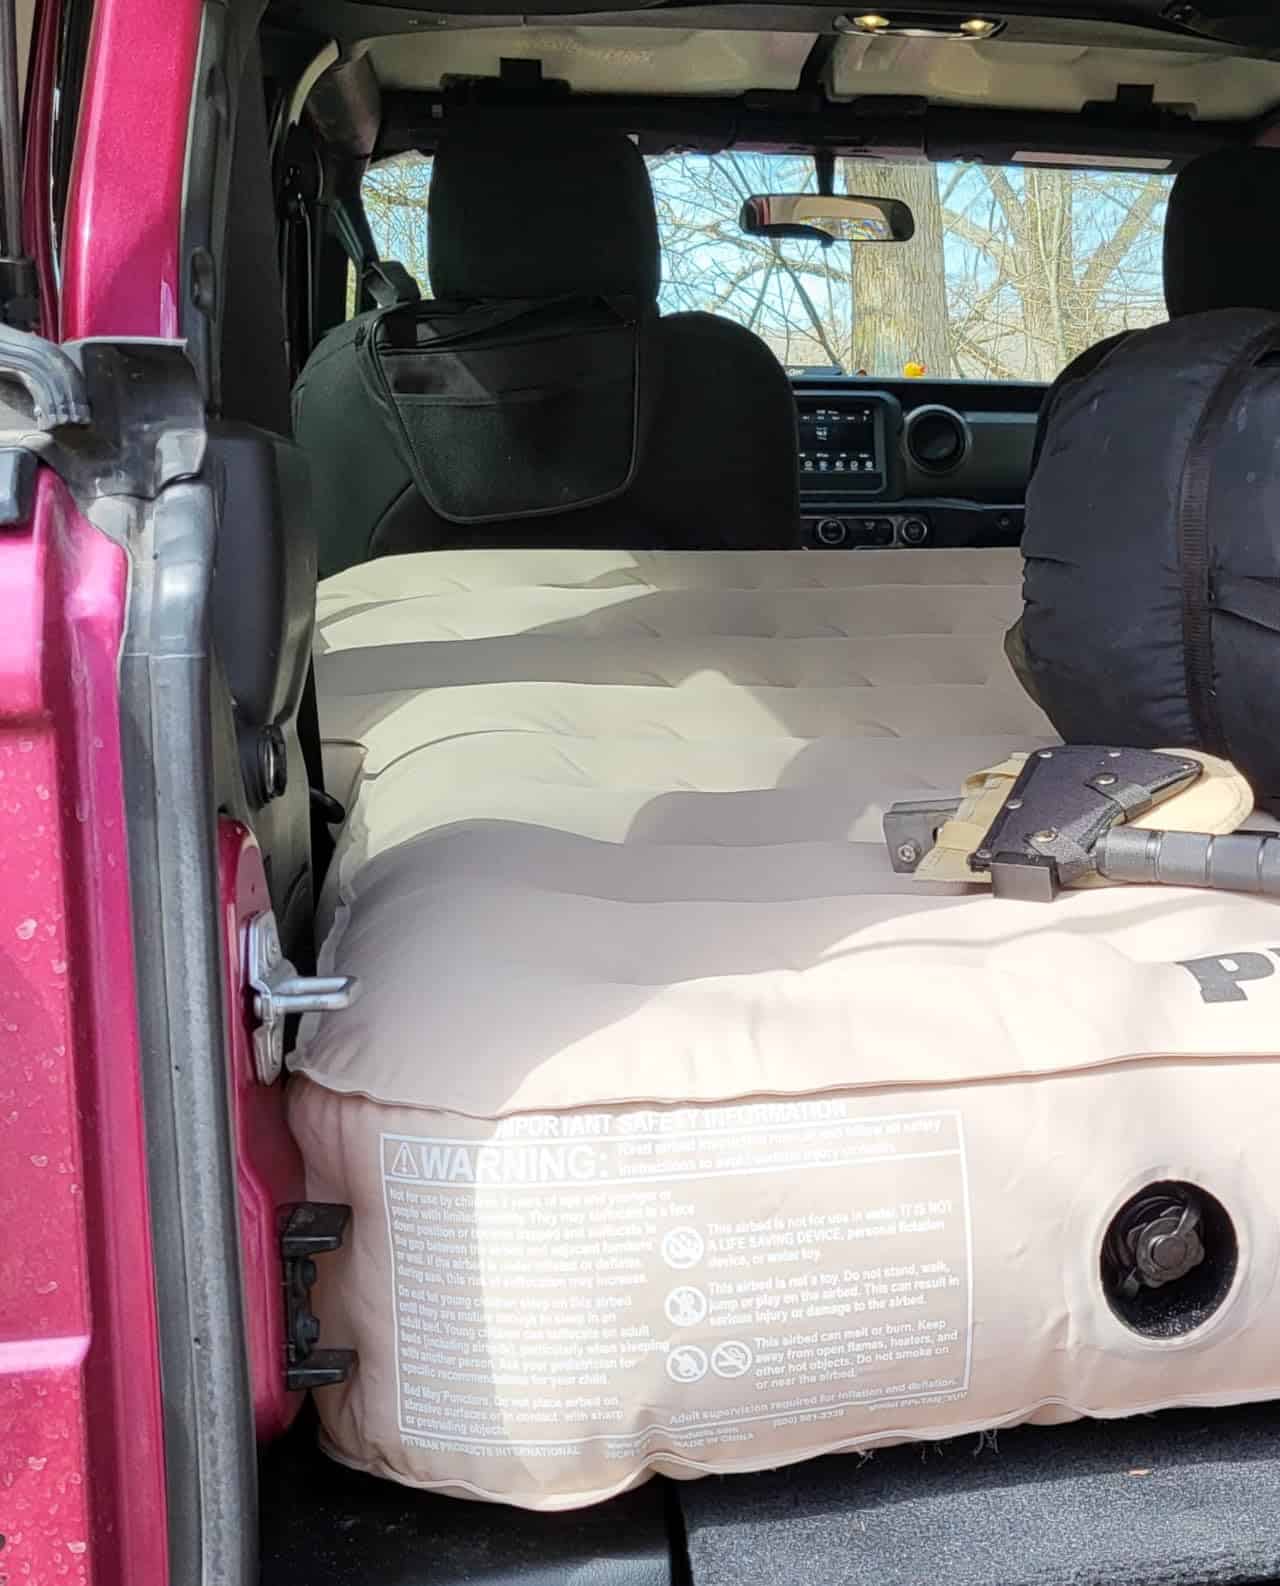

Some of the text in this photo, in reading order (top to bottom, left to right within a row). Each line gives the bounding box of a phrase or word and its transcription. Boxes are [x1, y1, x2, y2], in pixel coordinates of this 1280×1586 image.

[421, 1145, 608, 1181] WARNING:
[707, 1222, 732, 1236] This
[719, 1235, 746, 1250] LIFE
[749, 1231, 794, 1248] SAVING
[708, 1280, 733, 1295] This
[843, 1268, 861, 1282] Do
[755, 1292, 782, 1310] play
[864, 1281, 889, 1296] This
[853, 1301, 867, 1313] to
[754, 1336, 780, 1350] This
[782, 1331, 819, 1346] airbed
[820, 1330, 842, 1342] can
[871, 1326, 884, 1337] or
[885, 1322, 916, 1336] burn.
[917, 1318, 947, 1332] Keep
[787, 1347, 815, 1361] from
[816, 1343, 846, 1359] open
[936, 1328, 959, 1342] and
[755, 1364, 786, 1379] other
[788, 1360, 808, 1375] hot
[856, 1353, 874, 1366] Do
[875, 1350, 894, 1363] not
[895, 1345, 933, 1361] smoke
[934, 1344, 951, 1356] on
[755, 1379, 769, 1392] or
[770, 1375, 796, 1389] near
[799, 1372, 818, 1386] the
